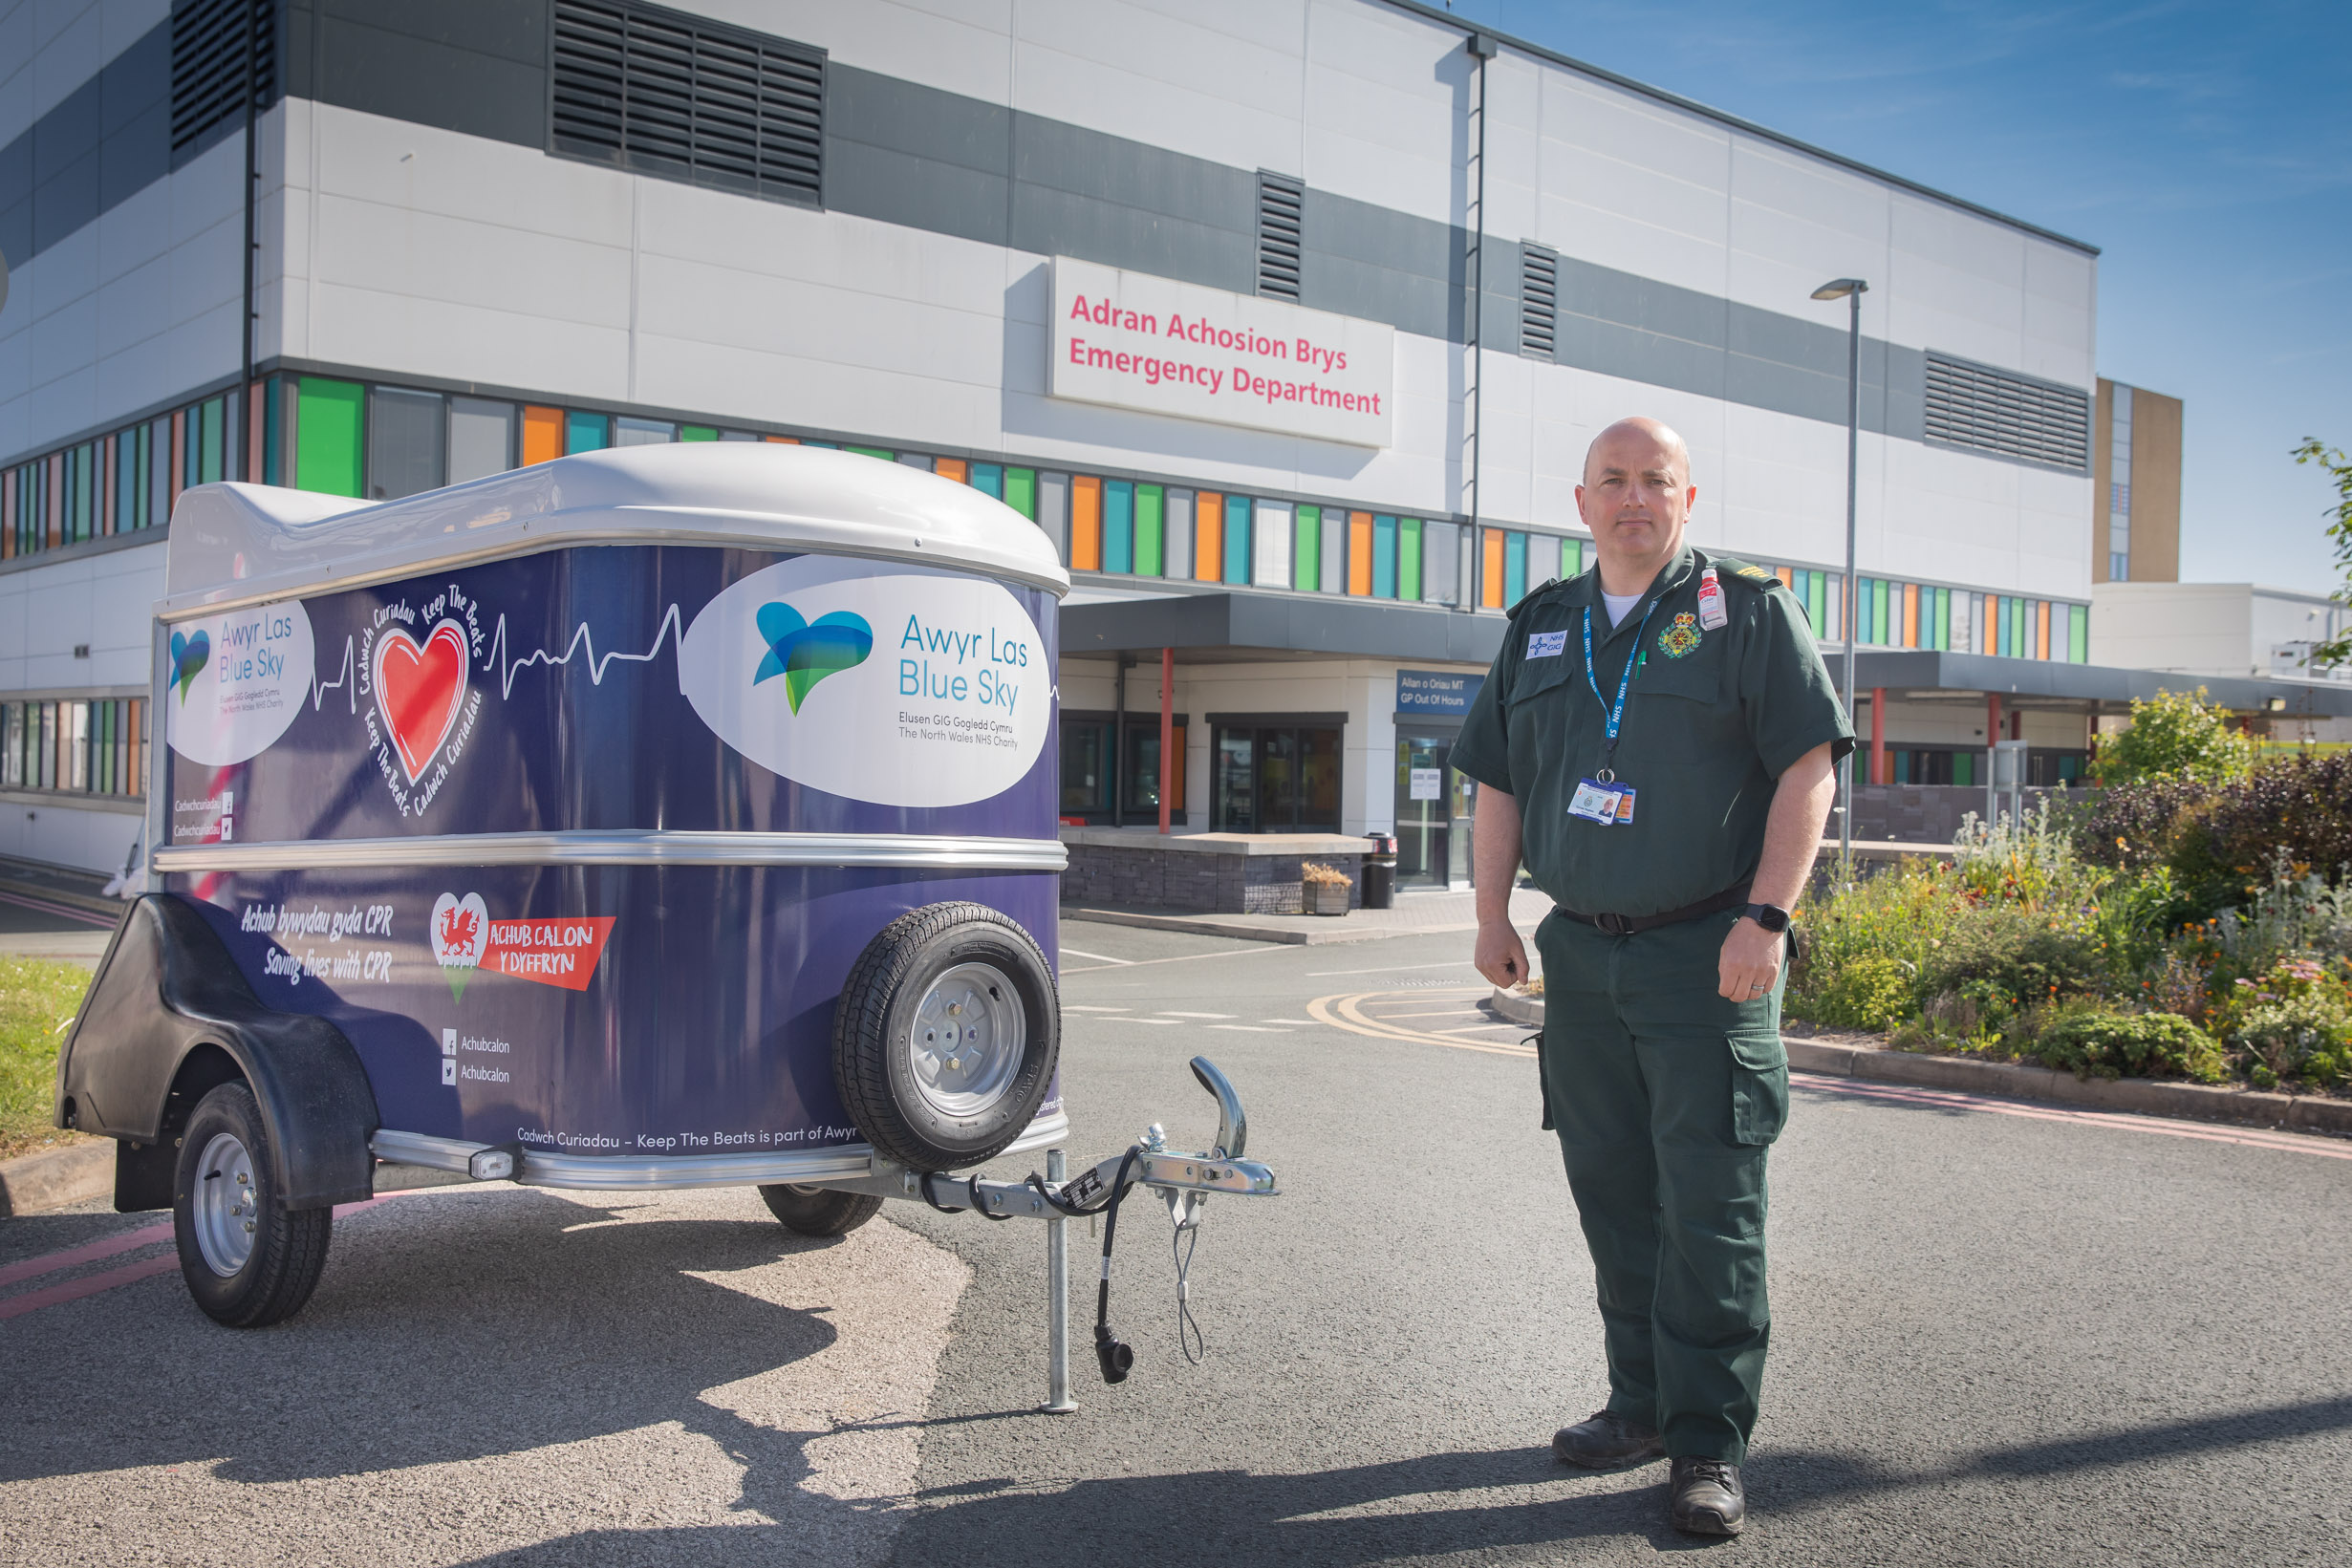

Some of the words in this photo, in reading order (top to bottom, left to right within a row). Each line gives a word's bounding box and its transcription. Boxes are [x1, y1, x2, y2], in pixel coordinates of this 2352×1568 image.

[1070, 294, 1156, 334] Adran
[1167, 313, 1287, 359] Achosion
[1296, 338, 1347, 374] Brys
[1069, 337, 1223, 395] Emergency
[1233, 367, 1381, 415] Department
[221, 620, 260, 651] Awyr
[265, 612, 291, 641] Las
[357, 627, 374, 695] Cadwch
[373, 597, 416, 629] Curiadau
[421, 593, 445, 625] Keep
[448, 584, 467, 612] The
[465, 600, 486, 657] Beats
[900, 613, 982, 665] Awyr
[991, 627, 1027, 667] Las
[220, 654, 252, 683] Blue
[257, 647, 285, 680] Sky
[899, 658, 968, 701] Blue
[978, 669, 1018, 717] Sky
[1401, 677, 1421, 688] Allan
[1430, 678, 1450, 690] Oriau
[1452, 680, 1464, 690] MT
[1618, 682, 1627, 699] NHS
[1401, 693, 1413, 703] GP
[1414, 694, 1429, 704] Out
[1431, 695, 1440, 704] Of
[1441, 696, 1464, 706] Hours
[899, 711, 931, 724] Elusen
[933, 715, 951, 726] GIG
[953, 717, 988, 731] Gogledd
[990, 720, 1013, 734] Cymru
[1612, 705, 1622, 722] NHS
[898, 726, 917, 739] The
[920, 729, 946, 741] North
[948, 731, 973, 743] Wales
[976, 734, 991, 745] NHS
[994, 736, 1018, 751] Charity
[364, 706, 380, 750] Keep
[378, 741, 392, 778] The
[388, 769, 410, 817] Beats
[414, 763, 448, 816] Cadwch
[446, 690, 482, 764] Curiadau
[241, 904, 276, 933] Achub
[277, 904, 330, 940] bywydau
[329, 904, 363, 942] gyda
[365, 905, 394, 937] CPR
[489, 924, 532, 948] ACHUB
[535, 925, 593, 947] CALON
[264, 947, 302, 986] Saving
[303, 948, 331, 977] lives
[333, 949, 360, 980] with
[364, 951, 392, 983] CPR
[500, 950, 508, 973] Y
[510, 951, 574, 975] DYFFRYN
[461, 1036, 510, 1054] Achubcalon
[461, 1064, 509, 1084] Achubcalon
[517, 1127, 554, 1145] Cadwch
[557, 1131, 619, 1148] Curiadau
[637, 1133, 677, 1150] Keep
[680, 1132, 709, 1147] The
[714, 1130, 756, 1146] Beats
[760, 1129, 770, 1143] is
[774, 1128, 805, 1146] part
[808, 1126, 823, 1140] of
[824, 1126, 857, 1141] Awyr
